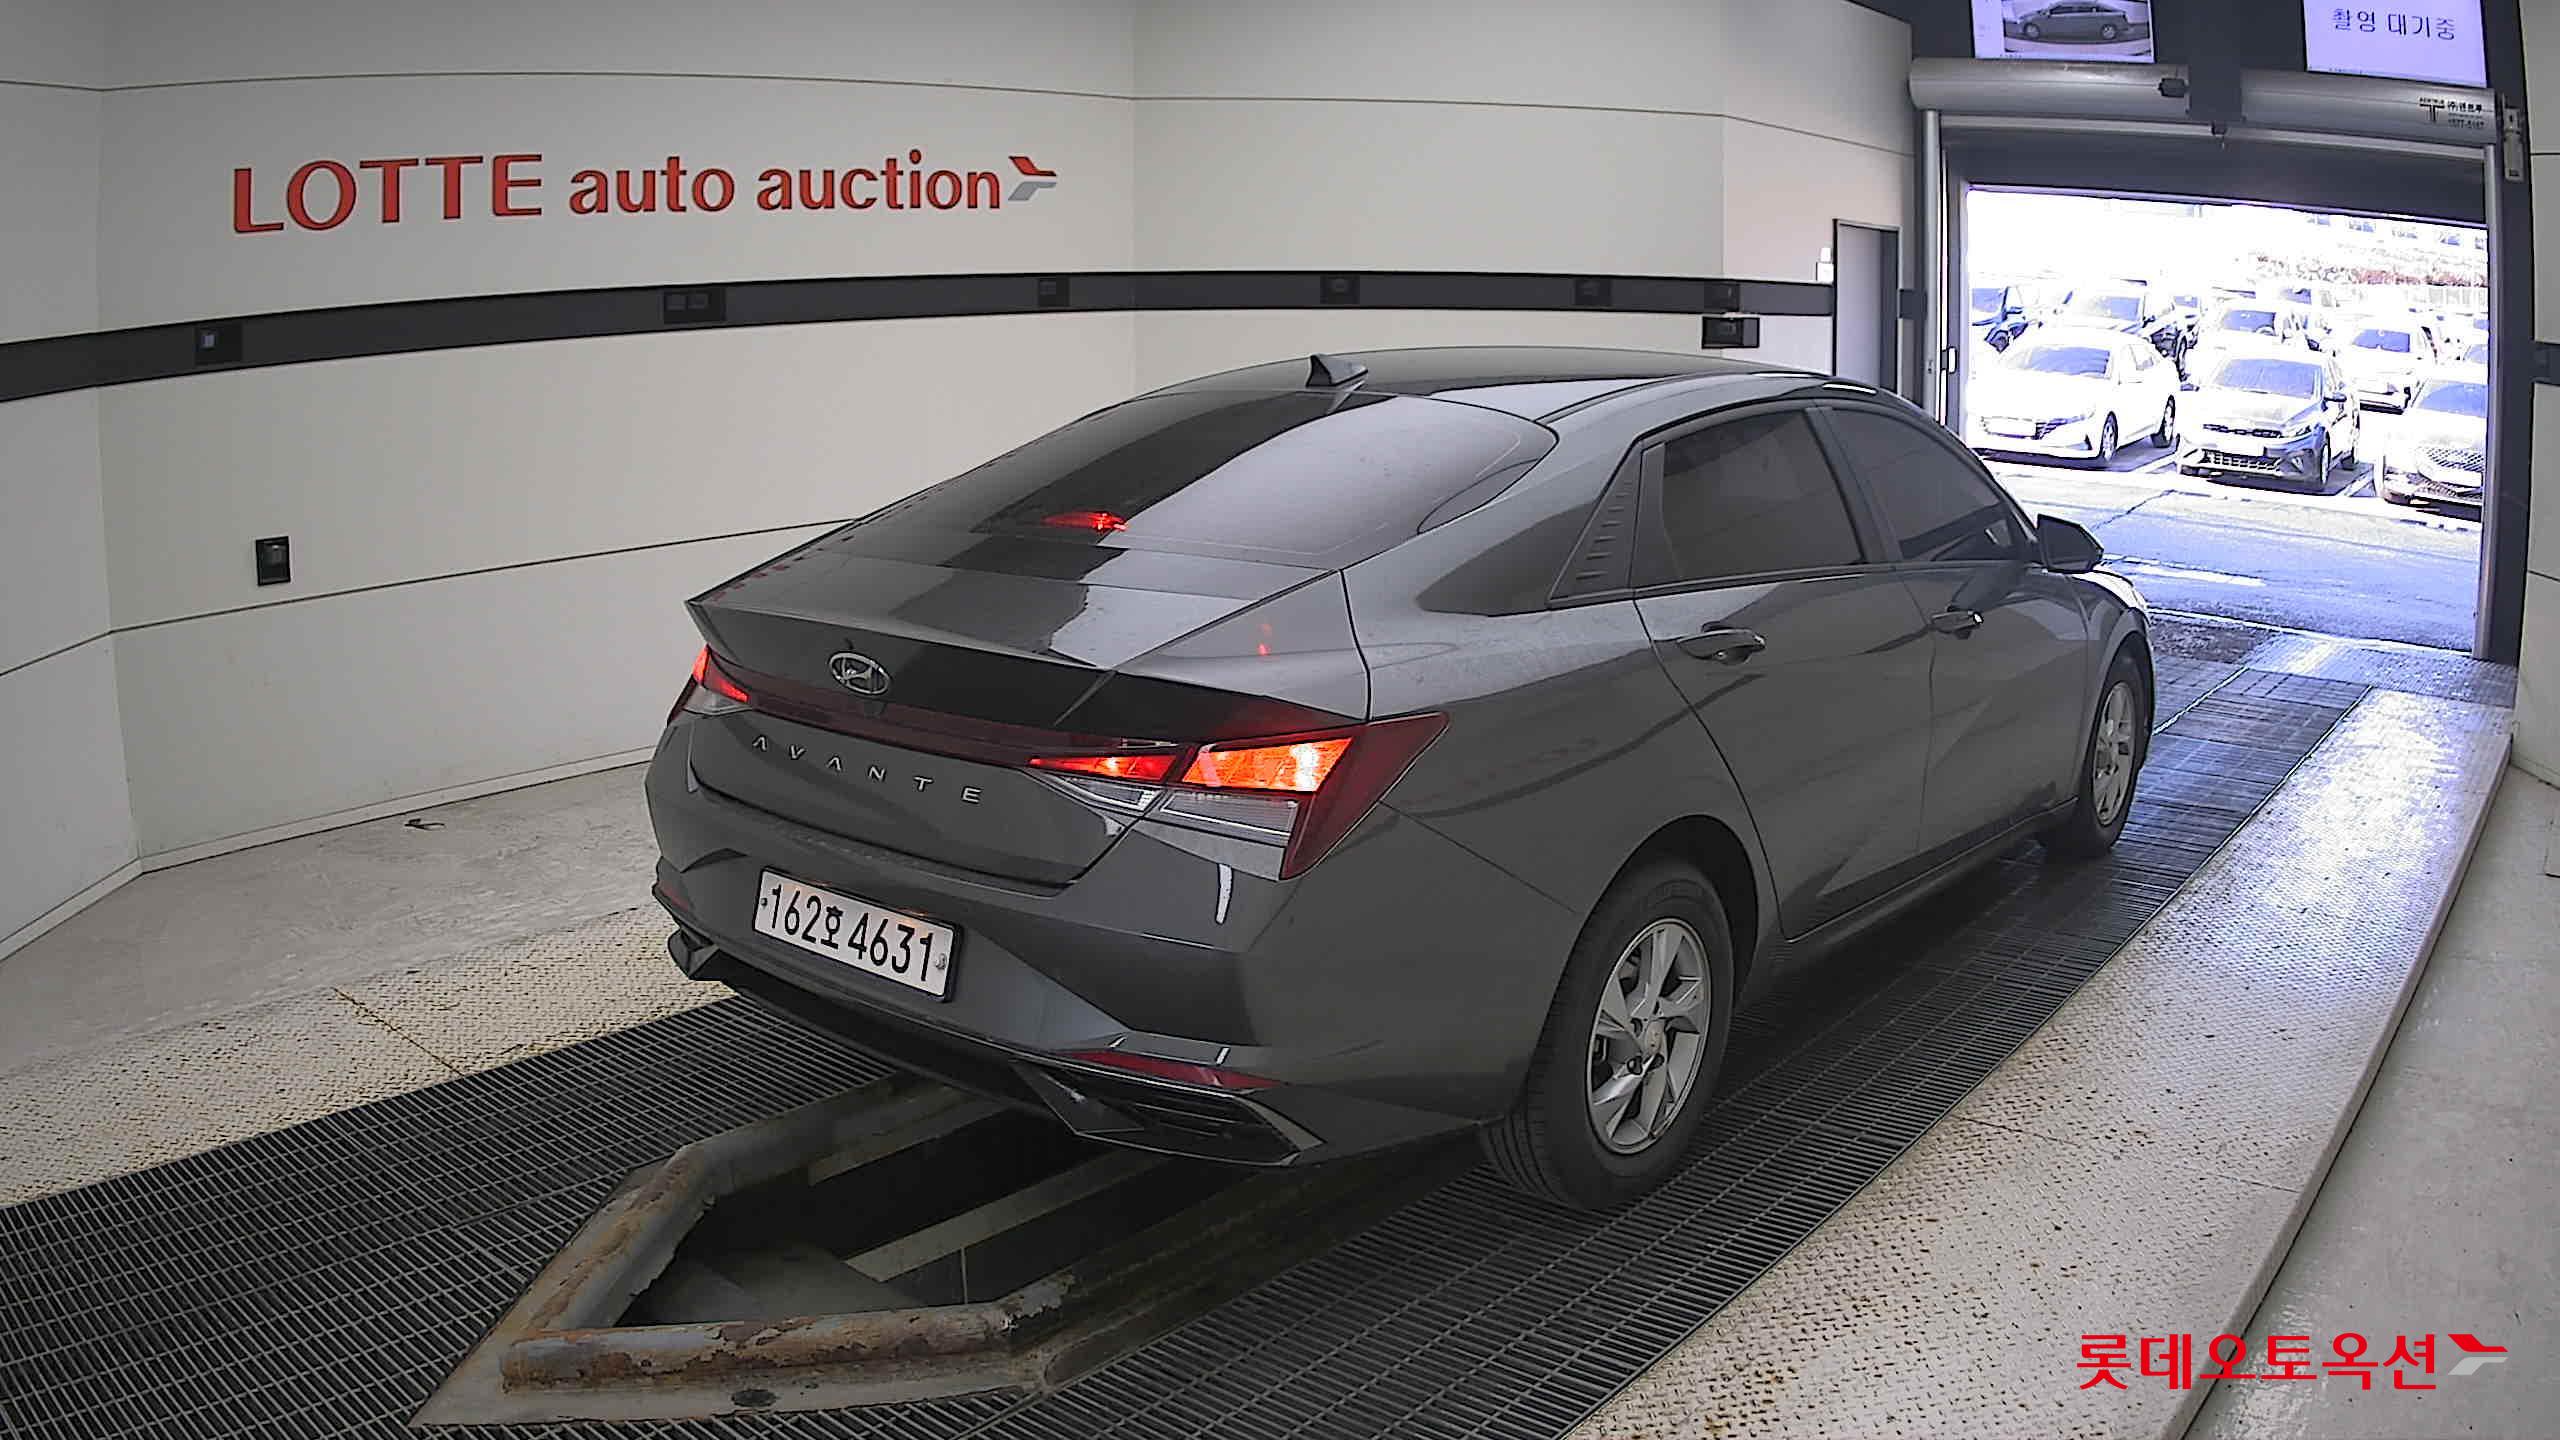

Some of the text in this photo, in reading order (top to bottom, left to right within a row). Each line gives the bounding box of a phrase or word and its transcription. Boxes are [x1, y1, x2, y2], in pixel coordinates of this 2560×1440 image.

[2332, 8, 2456, 41] 촬영 대기중
[233, 149, 1003, 233] LOTTE auto auction
[752, 735, 982, 804] AVANTE
